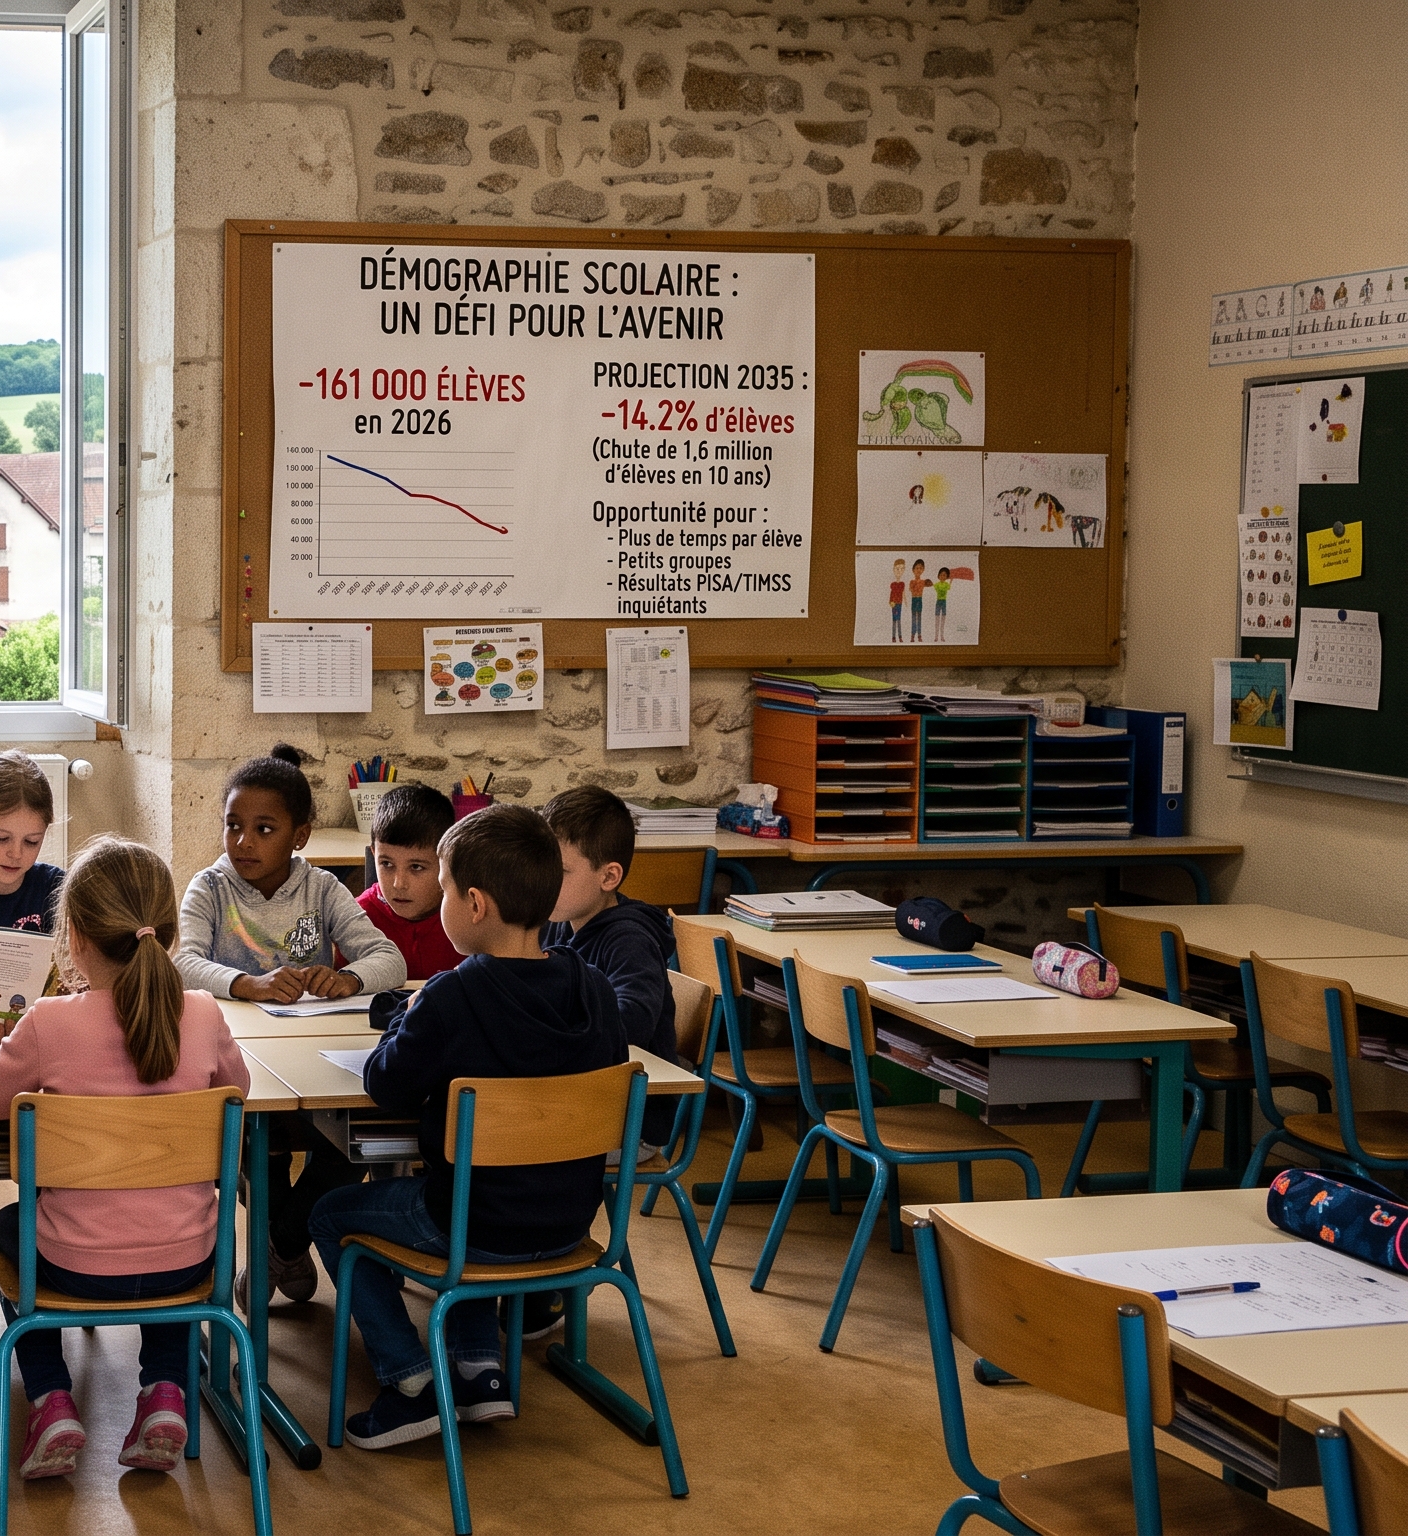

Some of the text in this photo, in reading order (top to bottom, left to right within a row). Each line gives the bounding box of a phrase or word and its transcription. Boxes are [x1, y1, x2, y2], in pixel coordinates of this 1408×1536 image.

[361, 247, 570, 294] DÉMOGRAPHIE
[583, 262, 720, 296] SCOLAIRE
[381, 293, 723, 340] UN DÉFI POUR L'AVENIR
[373, 369, 426, 400] 000
[438, 366, 525, 402] ÉLÈVES
[595, 362, 728, 389] PROJECTION
[738, 365, 793, 390] 2035
[355, 409, 451, 435] en 2026
[706, 407, 794, 433] d'élèves
[593, 437, 772, 462] (Chute de 1,6 million
[606, 463, 770, 488] d'élèves en 10 ans)
[594, 501, 706, 527] Opportunité
[714, 508, 756, 528] pour
[290, 535, 313, 543] 40 000
[619, 529, 650, 546] Plus
[656, 529, 674, 546] de
[680, 529, 726, 551] temps
[733, 534, 757, 550] par
[762, 529, 802, 547] élève
[290, 553, 313, 561] 20 000
[619, 551, 663, 568] Petits
[670, 556, 731, 573] groupes
[307, 571, 313, 579] 0
[619, 573, 691, 591] Résultats
[697, 573, 791, 592] PISA/TIMSS
[618, 596, 707, 618] inquiétants
